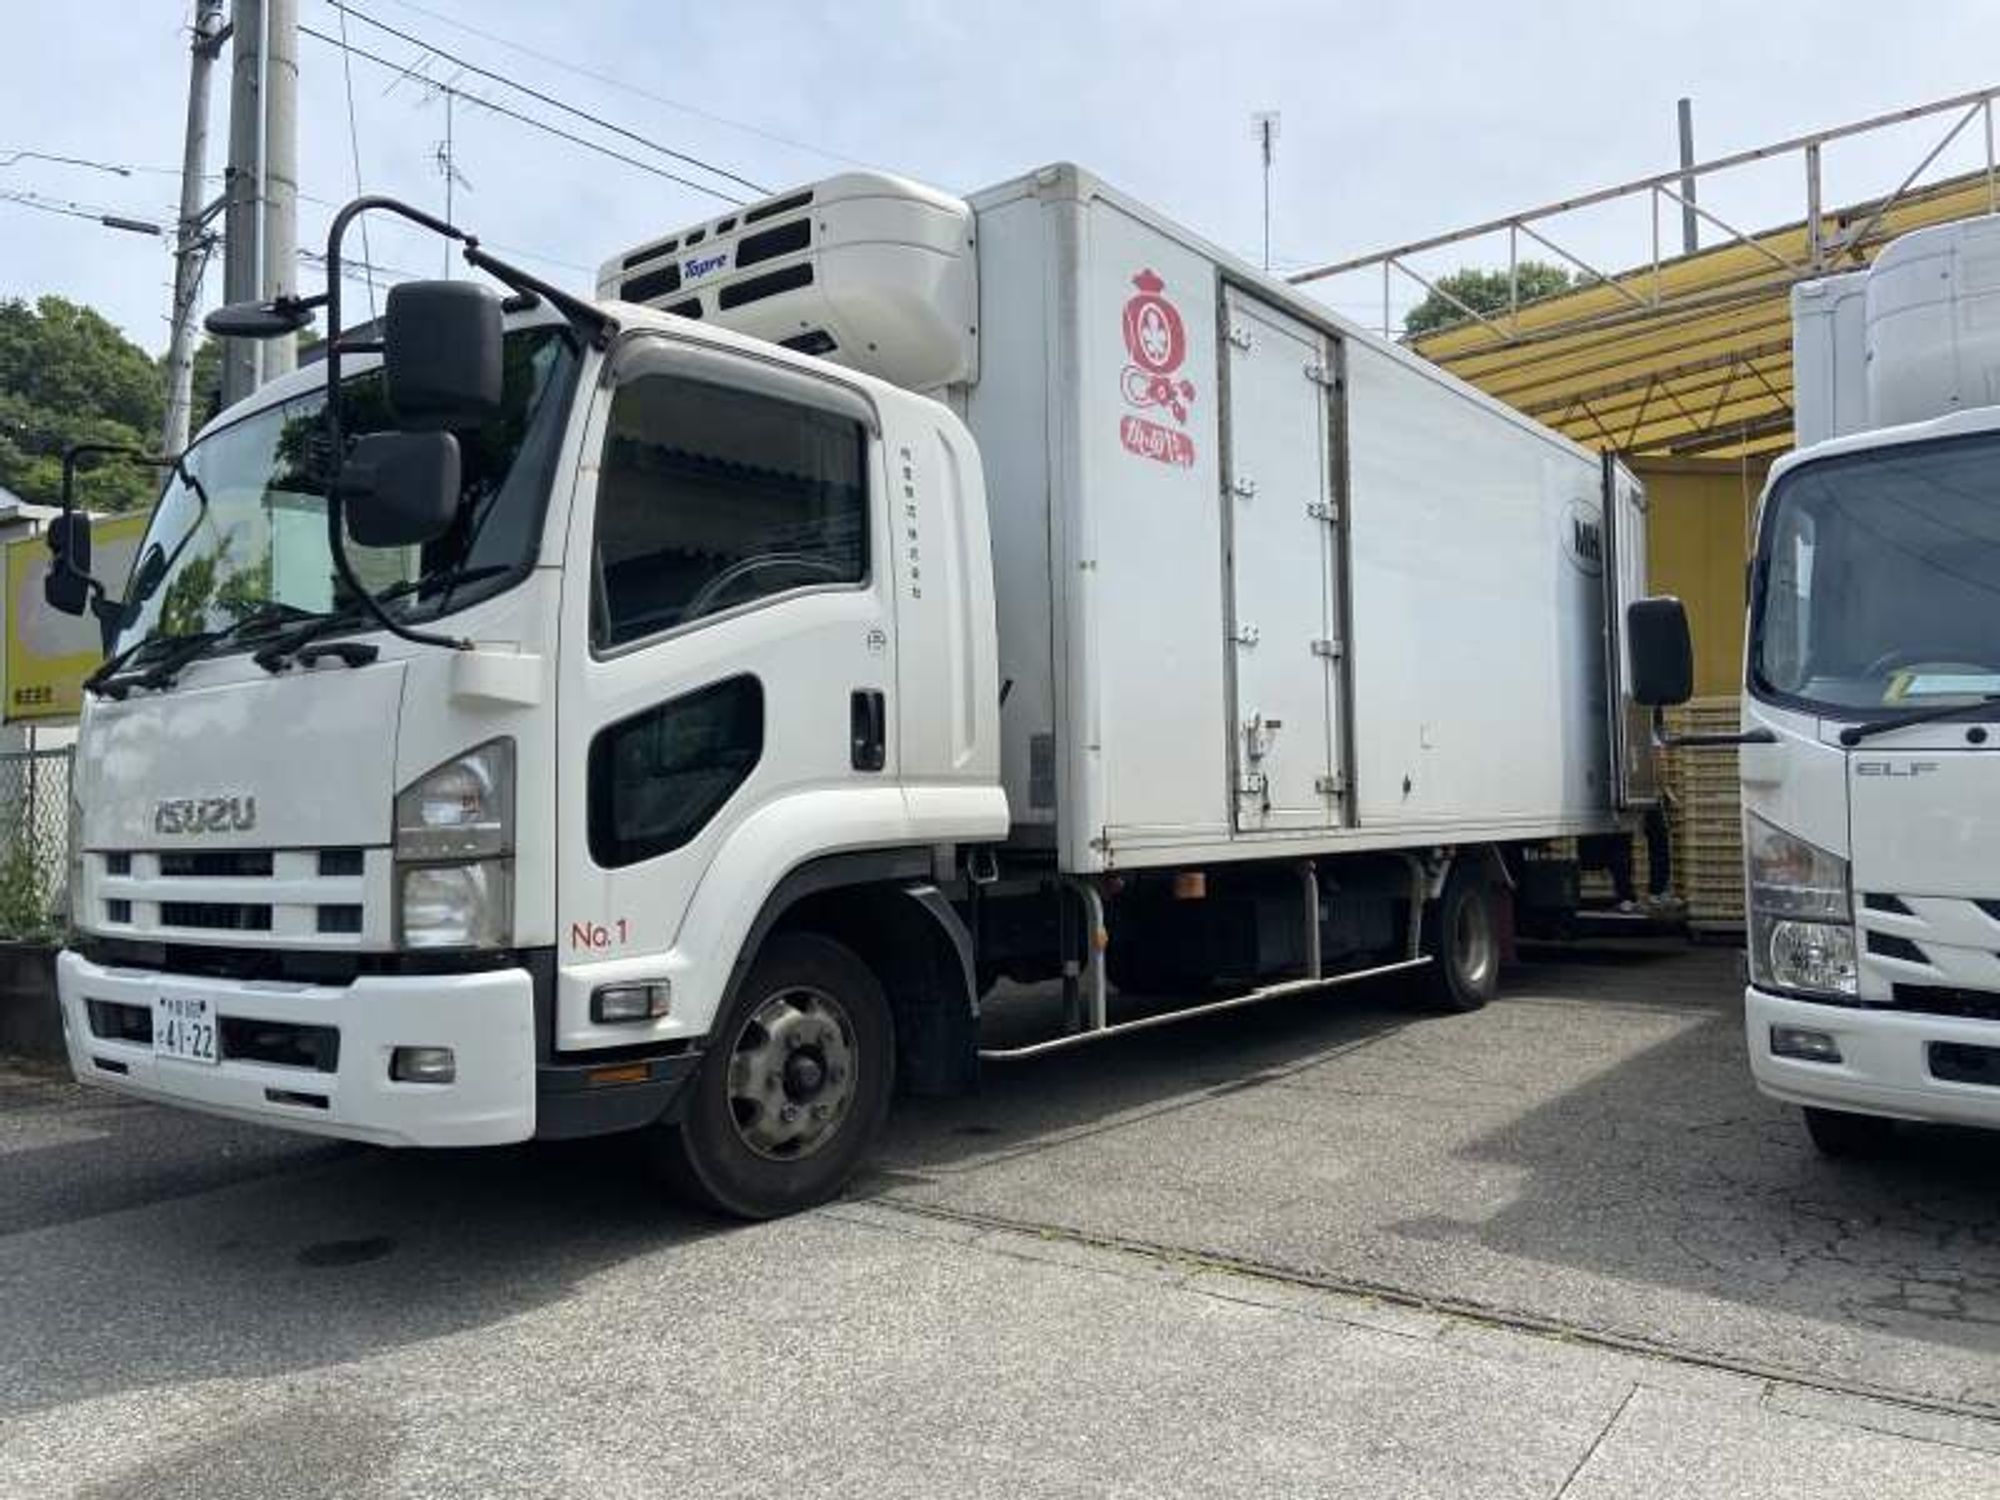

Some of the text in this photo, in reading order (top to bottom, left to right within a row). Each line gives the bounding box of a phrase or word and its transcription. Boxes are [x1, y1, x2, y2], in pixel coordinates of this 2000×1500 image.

[685, 254, 727, 279] Topre
[1857, 761, 1941, 777] ELF
[155, 797, 256, 834] ISUZU
